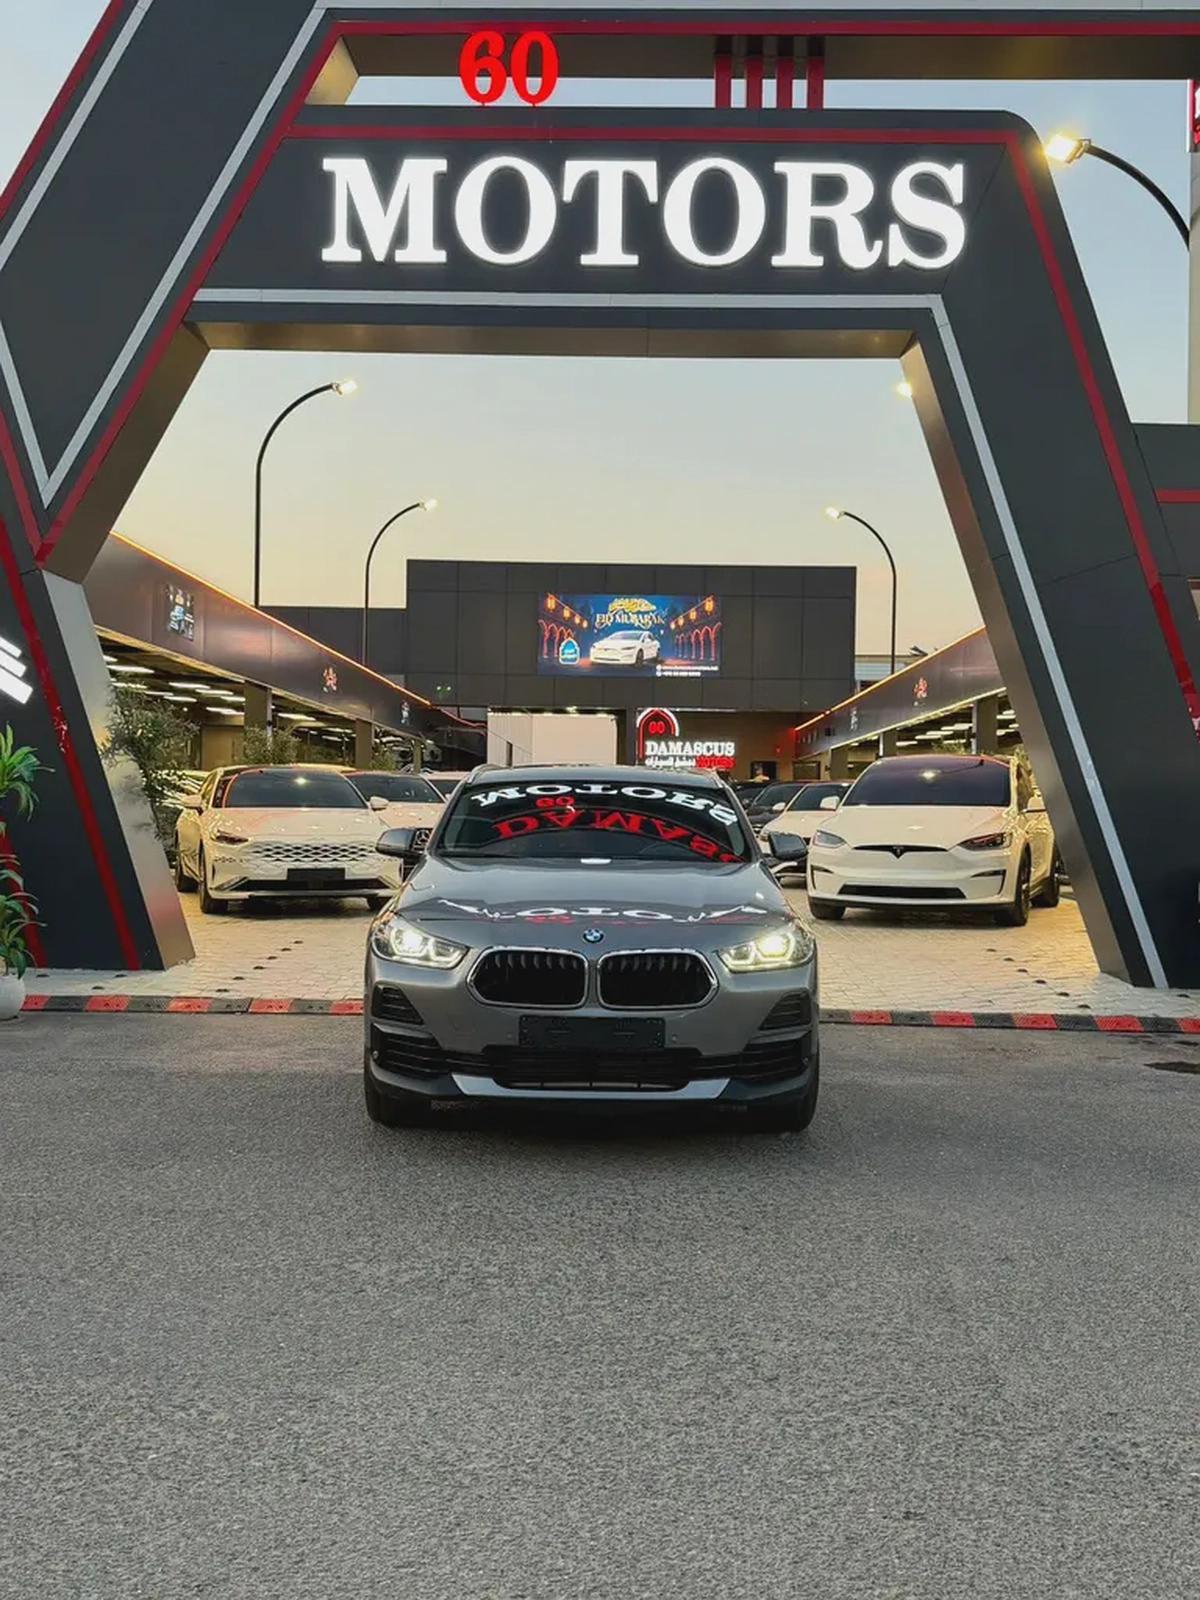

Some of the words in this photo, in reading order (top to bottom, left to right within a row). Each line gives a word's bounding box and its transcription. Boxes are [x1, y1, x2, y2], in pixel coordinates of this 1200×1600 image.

[459, 31, 559, 106] 60
[321, 156, 967, 270] MOTORS
[645, 741, 735, 756] DAMASCUS
